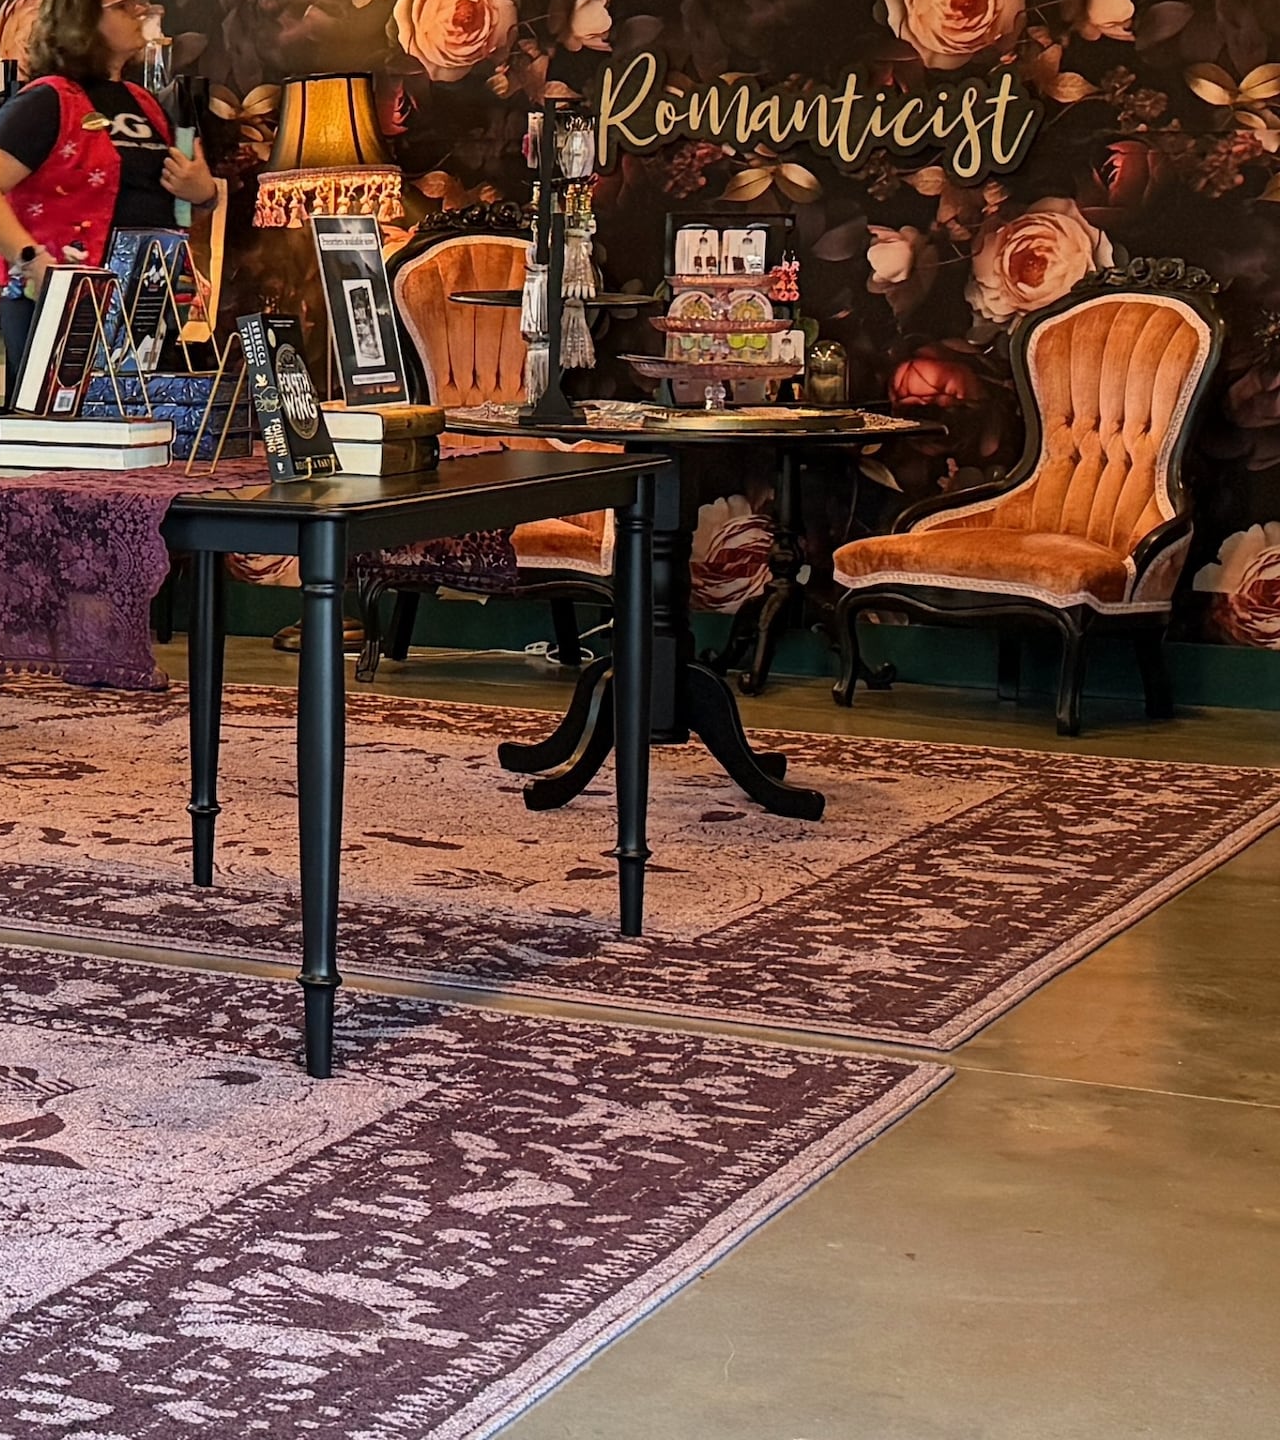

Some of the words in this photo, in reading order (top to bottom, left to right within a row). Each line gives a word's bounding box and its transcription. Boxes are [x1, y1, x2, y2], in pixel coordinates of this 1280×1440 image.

[240, 327, 255, 366] YARROS
[251, 321, 267, 366] REBECCA
[277, 372, 311, 395] FOURTH
[281, 392, 318, 421] WING
[263, 427, 277, 453] WING
[270, 418, 288, 458] FOURTH
